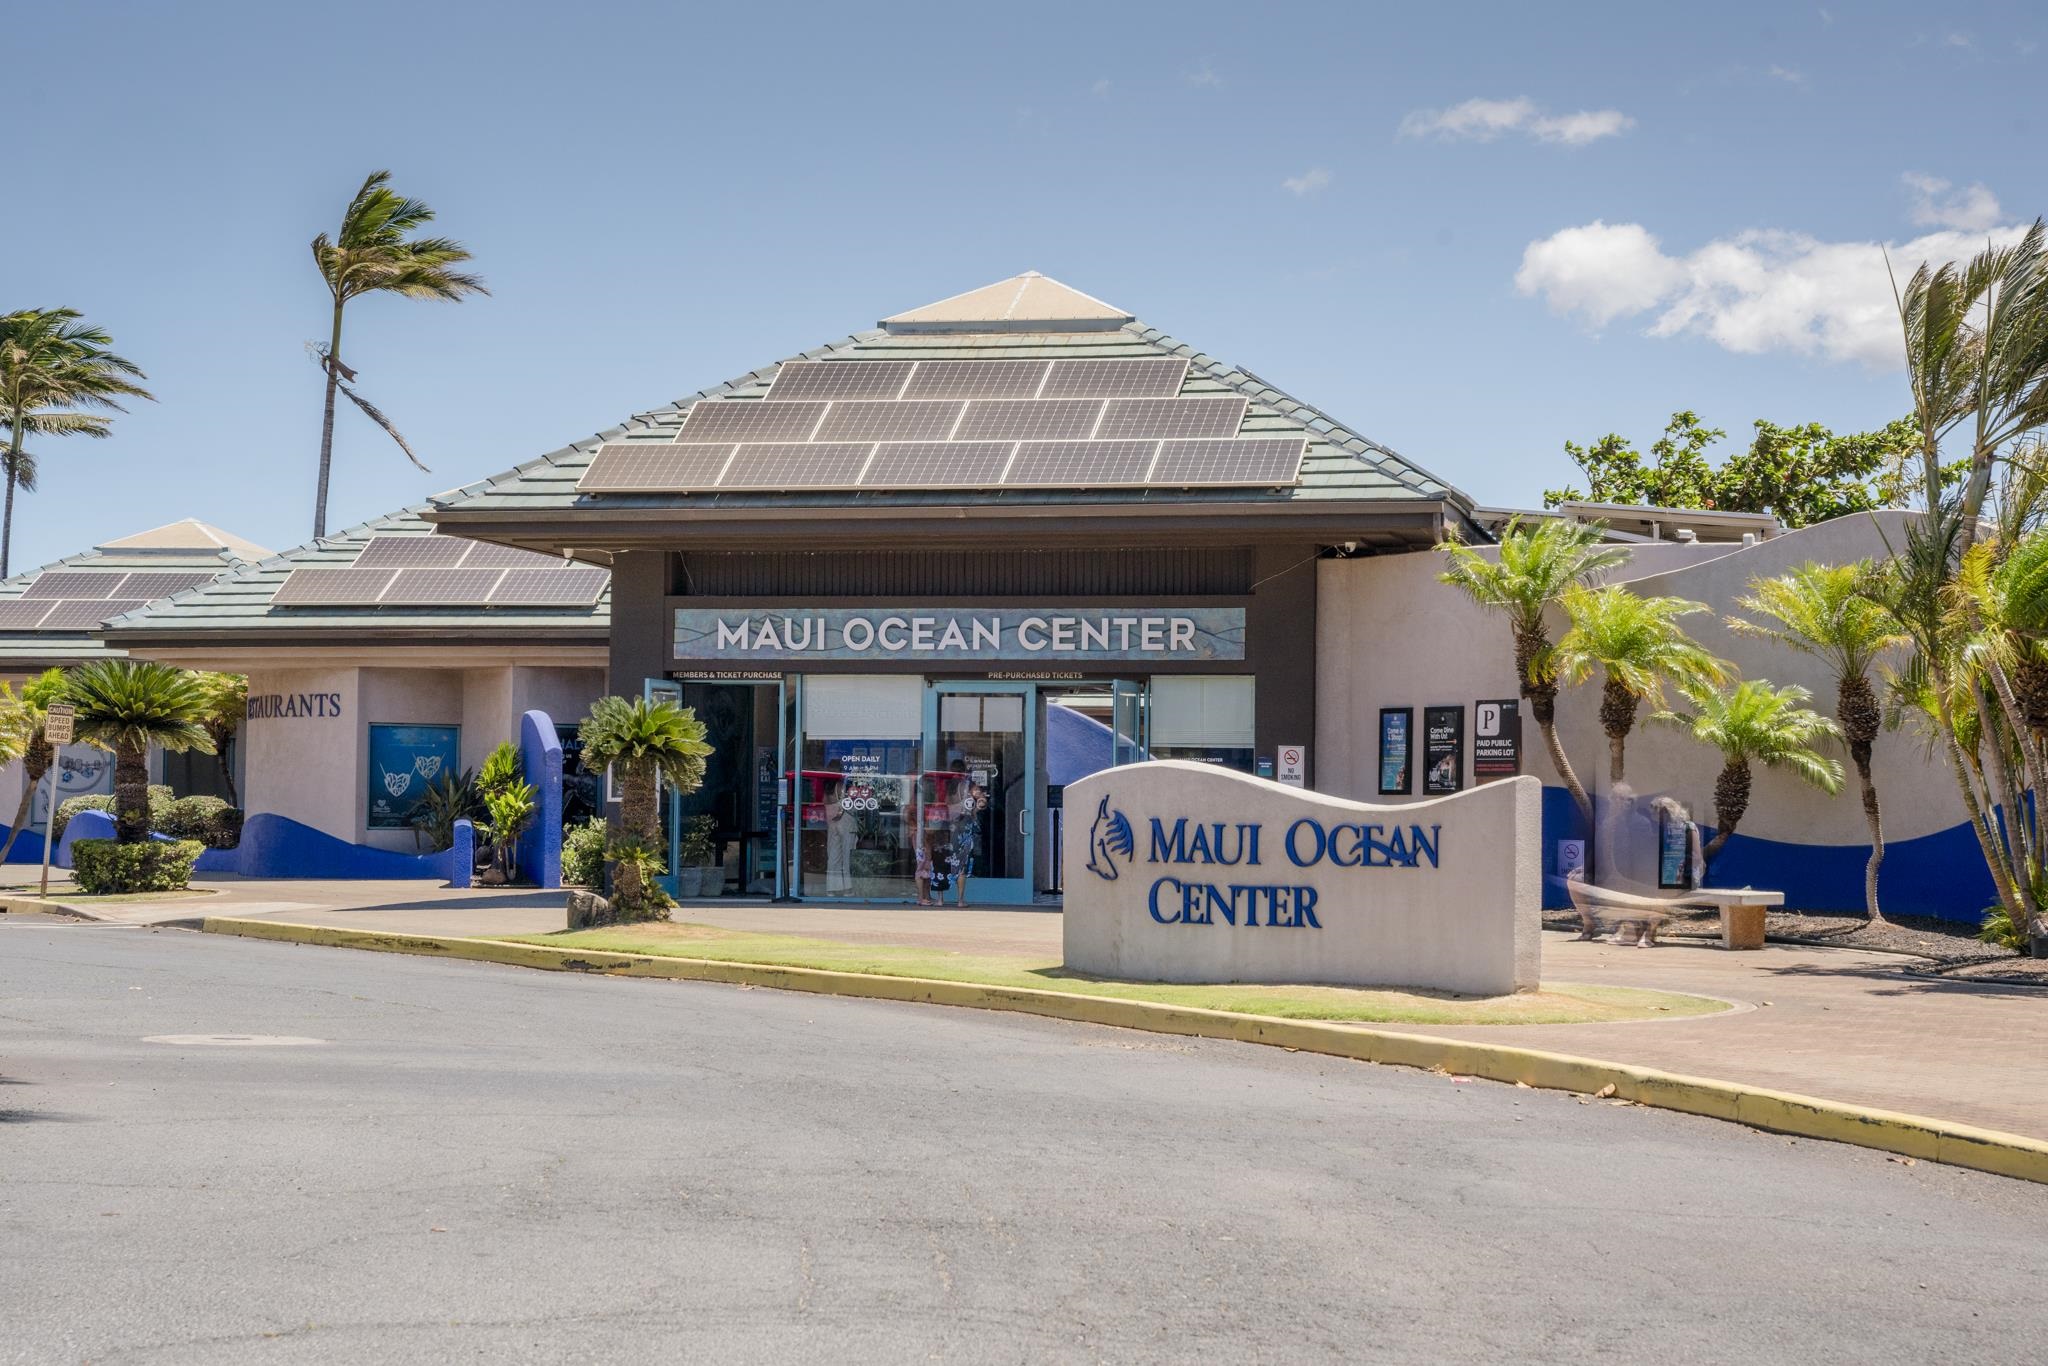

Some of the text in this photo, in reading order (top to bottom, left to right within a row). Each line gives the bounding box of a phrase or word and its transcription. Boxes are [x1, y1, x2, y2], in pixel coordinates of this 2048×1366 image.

[717, 617, 1197, 651] MAUI OCEAN CENTER
[672, 671, 782, 679] MEMBERS & TICKET PURCHASE
[988, 671, 1083, 679] PRE-PURCHASED TICKETS
[49, 706, 73, 715] CAUTION
[50, 716, 70, 725] SPEED
[1482, 710, 1495, 730] P
[48, 724, 71, 732] BUMPS
[1430, 726, 1455, 735] Come Dine
[47, 732, 69, 740] AHEAD
[1476, 739, 1512, 747] PAID PUBLIC
[1503, 749, 1515, 757] LOT
[1147, 817, 1442, 869] MAUI OCEAN
[1147, 876, 1323, 929] CENTER
